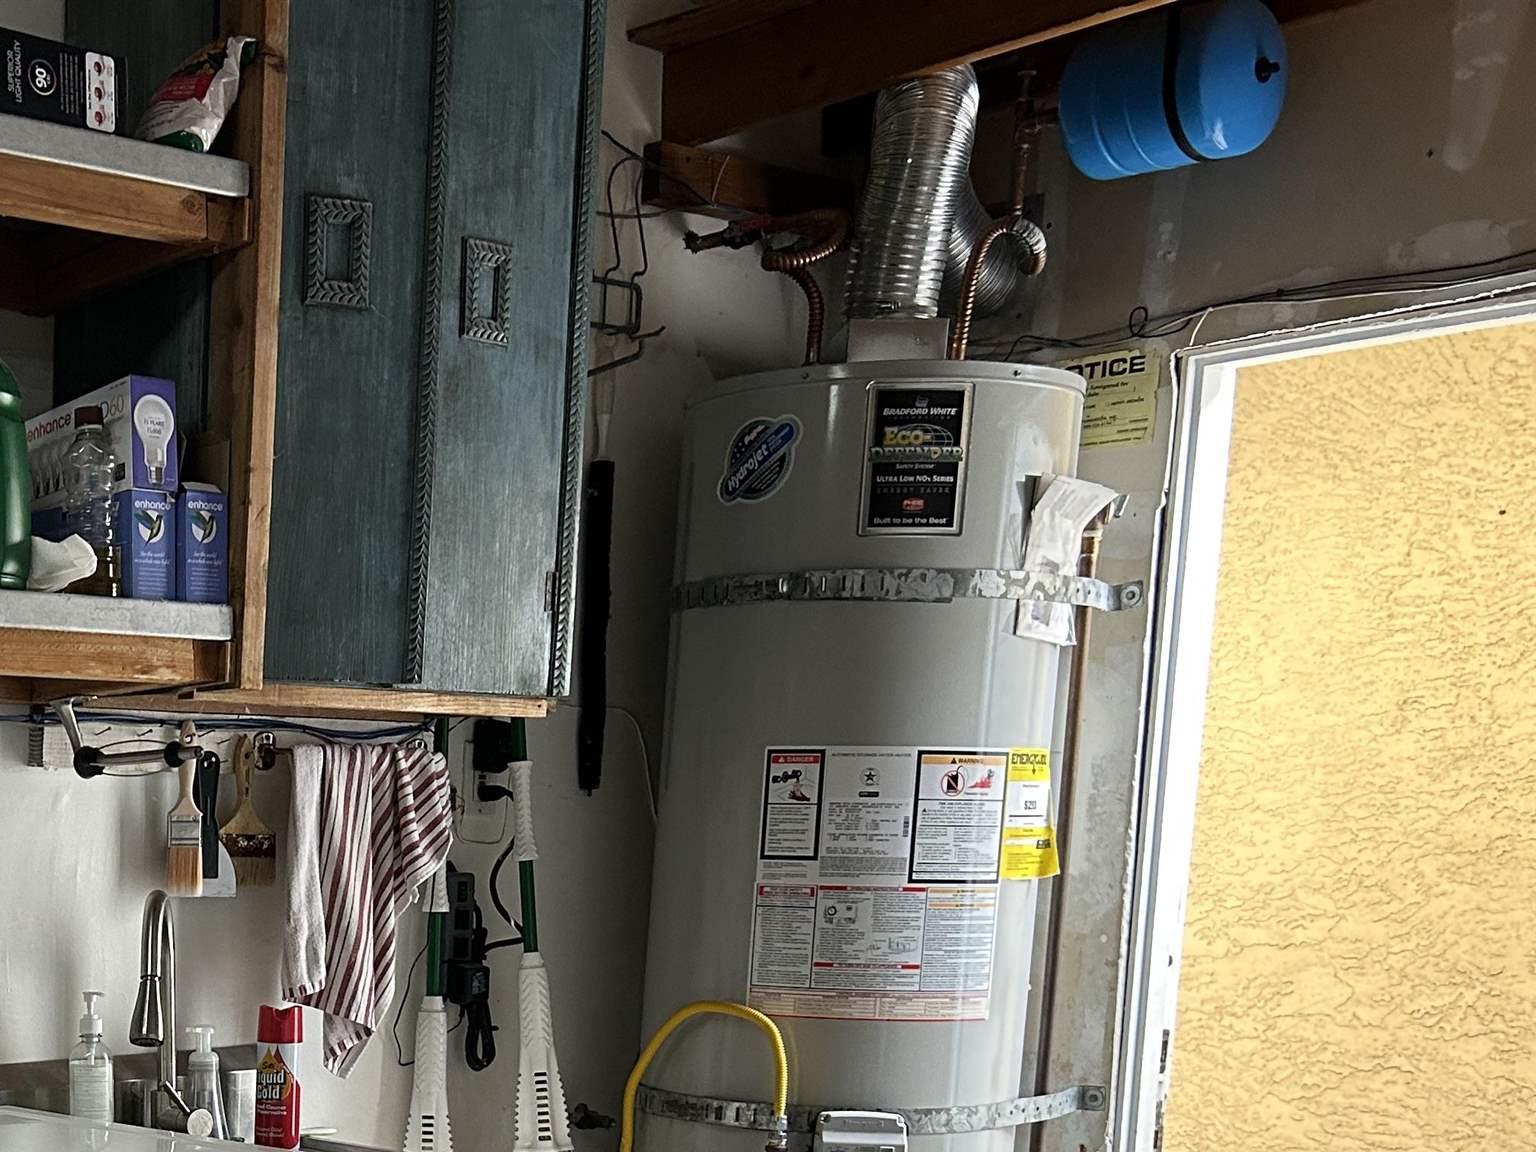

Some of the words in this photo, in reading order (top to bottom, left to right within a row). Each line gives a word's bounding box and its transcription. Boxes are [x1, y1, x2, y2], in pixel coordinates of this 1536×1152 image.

[35, 67, 47, 88] 90
[882, 407, 928, 416] BRADFORD
[929, 407, 958, 416] WHITE
[27, 412, 72, 442] enhance
[870, 446, 964, 460] DEFENDER
[727, 443, 768, 492] Hydrojet
[877, 475, 898, 483] ULTRA
[933, 474, 954, 483] SERIES
[134, 500, 171, 512] enhance
[188, 500, 224, 512] enhance
[873, 517, 891, 525] Built
[892, 517, 900, 525] to
[901, 517, 913, 525] be
[913, 517, 927, 525] the
[928, 517, 948, 525] Best
